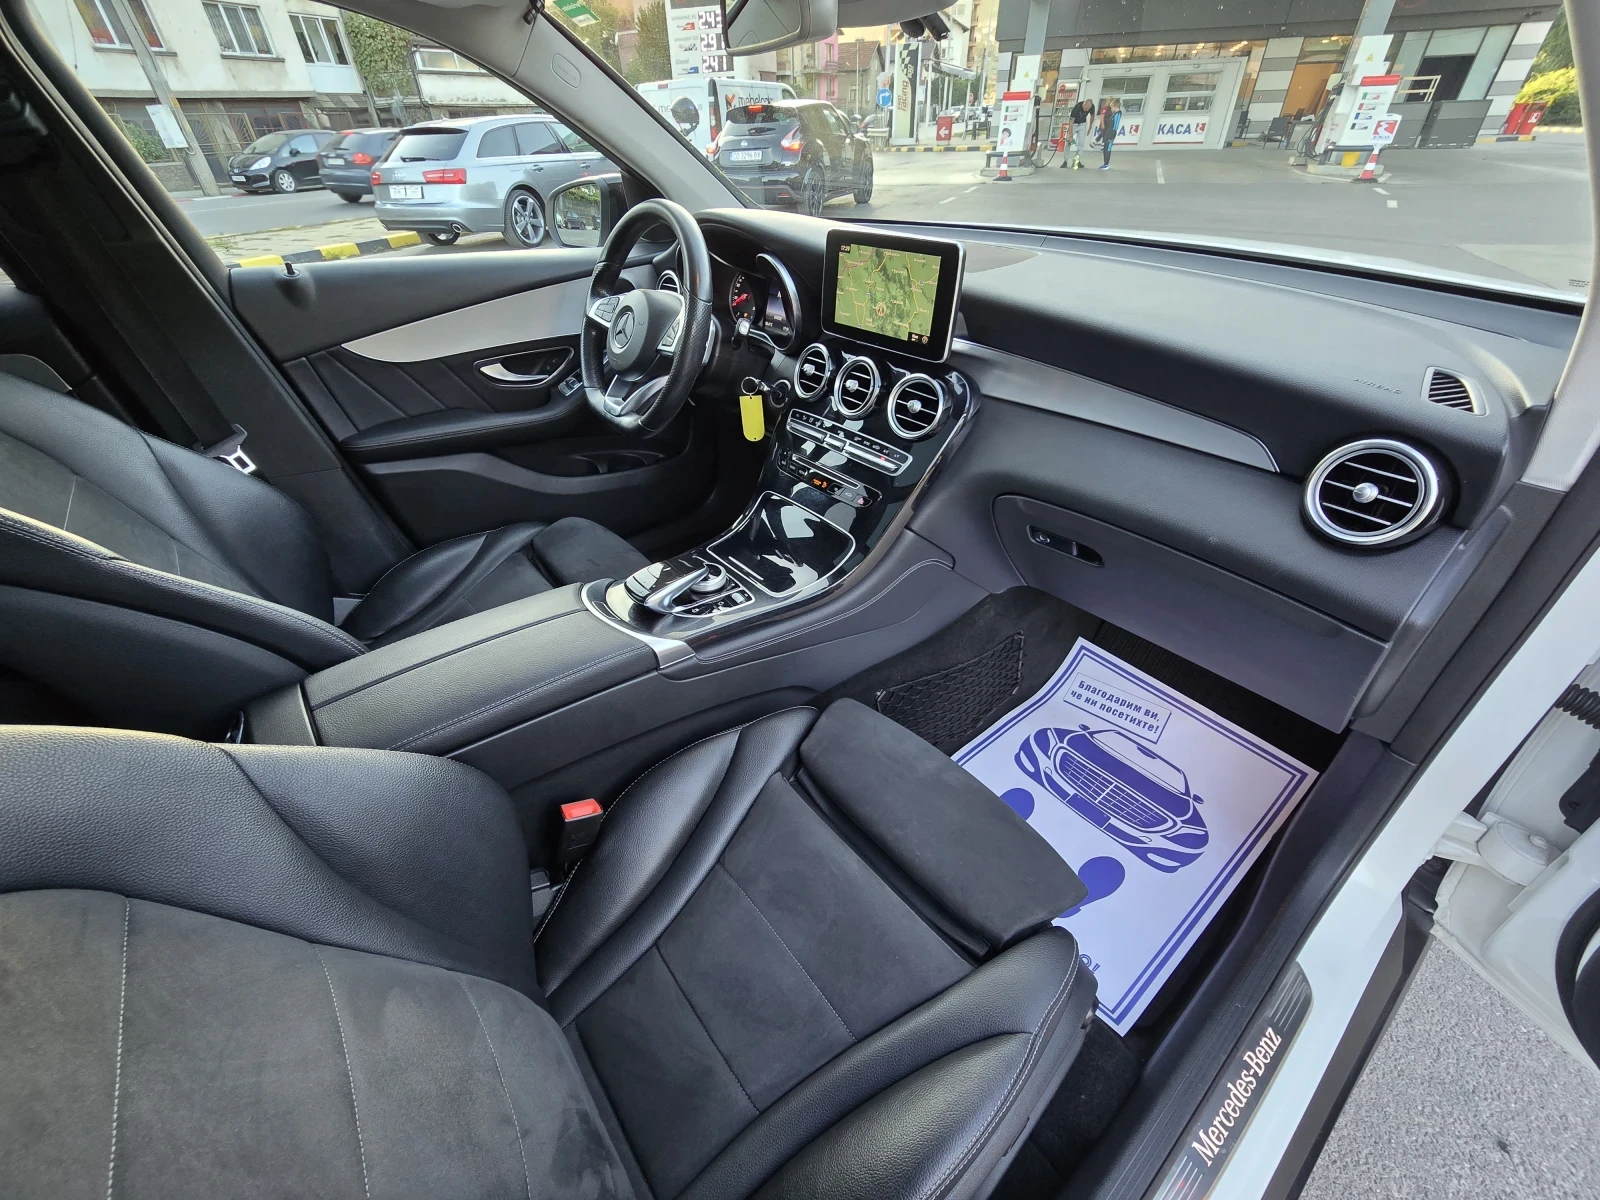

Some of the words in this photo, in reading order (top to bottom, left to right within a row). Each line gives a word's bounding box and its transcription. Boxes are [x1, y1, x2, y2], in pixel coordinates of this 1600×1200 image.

[702, 55, 727, 73] 2.41
[901, 80, 909, 112] racing
[1094, 125, 1126, 136] КА
[1157, 124, 1192, 135] КАСА
[1070, 690, 1082, 700] че
[1084, 696, 1098, 707] ни
[1099, 701, 1160, 734] посетихте!
[1078, 680, 1142, 714] Благодарим
[1144, 709, 1160, 722] ви,
[1191, 1026, 1282, 1168] Mercedes-Benz
